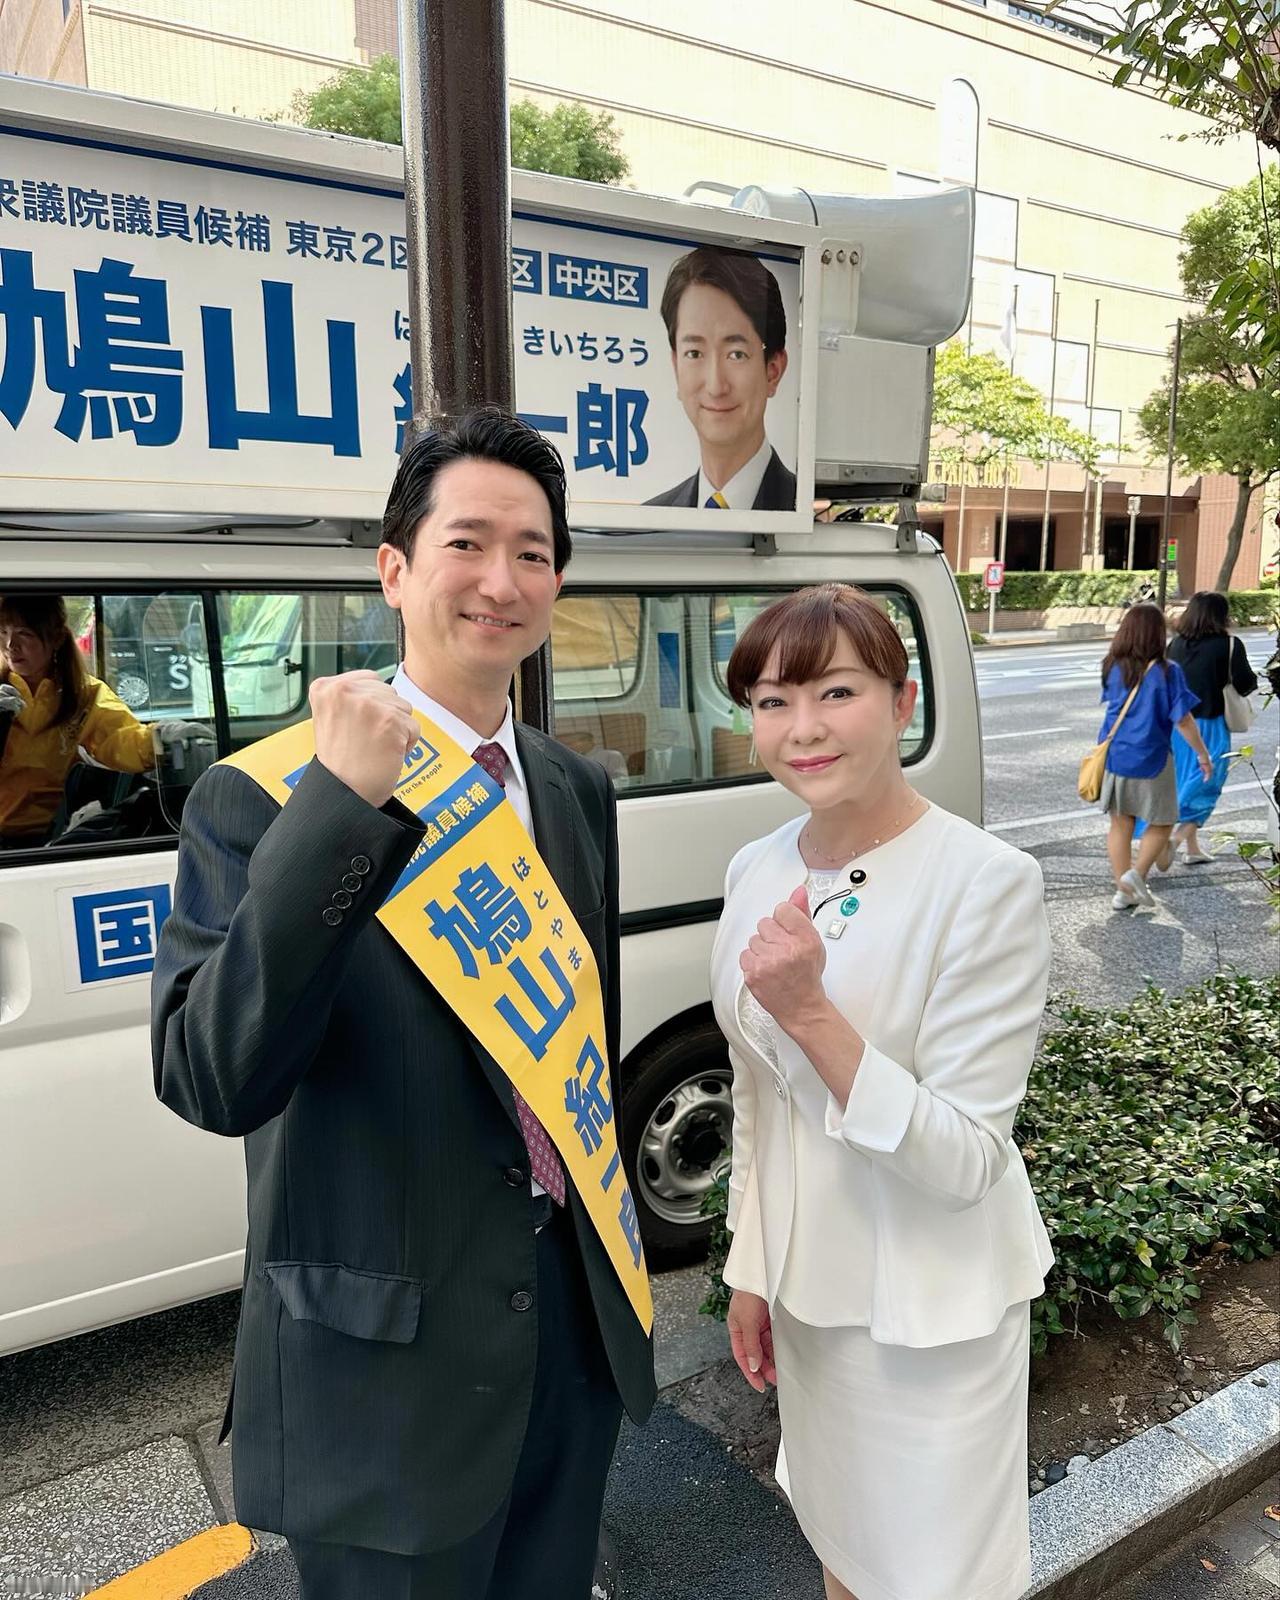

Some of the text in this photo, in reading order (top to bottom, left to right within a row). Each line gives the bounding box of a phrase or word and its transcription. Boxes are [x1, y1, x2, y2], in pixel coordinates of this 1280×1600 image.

[554, 264, 640, 303] 中央区
[522, 325, 650, 368] きいちろう
[420, 762, 443, 783] People
[92, 900, 158, 967] 国
[510, 854, 584, 971] はとやま
